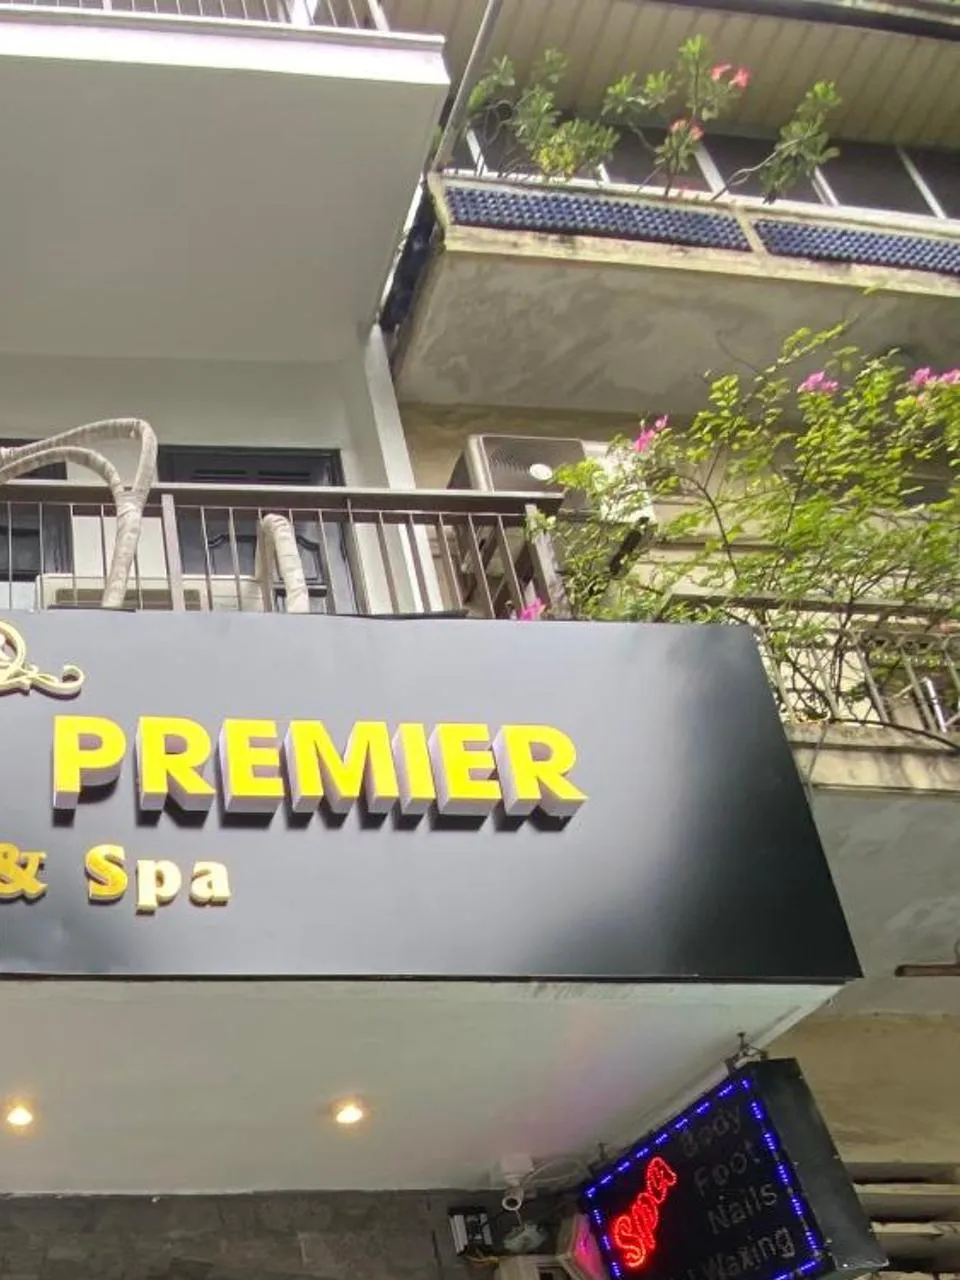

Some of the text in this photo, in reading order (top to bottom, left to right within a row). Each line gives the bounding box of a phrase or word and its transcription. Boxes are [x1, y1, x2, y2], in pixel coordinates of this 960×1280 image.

[52, 715, 588, 815] PREMIER
[84, 845, 232, 914] Spa
[613, 1156, 678, 1269] Spa
[707, 1182, 777, 1236] Nails
